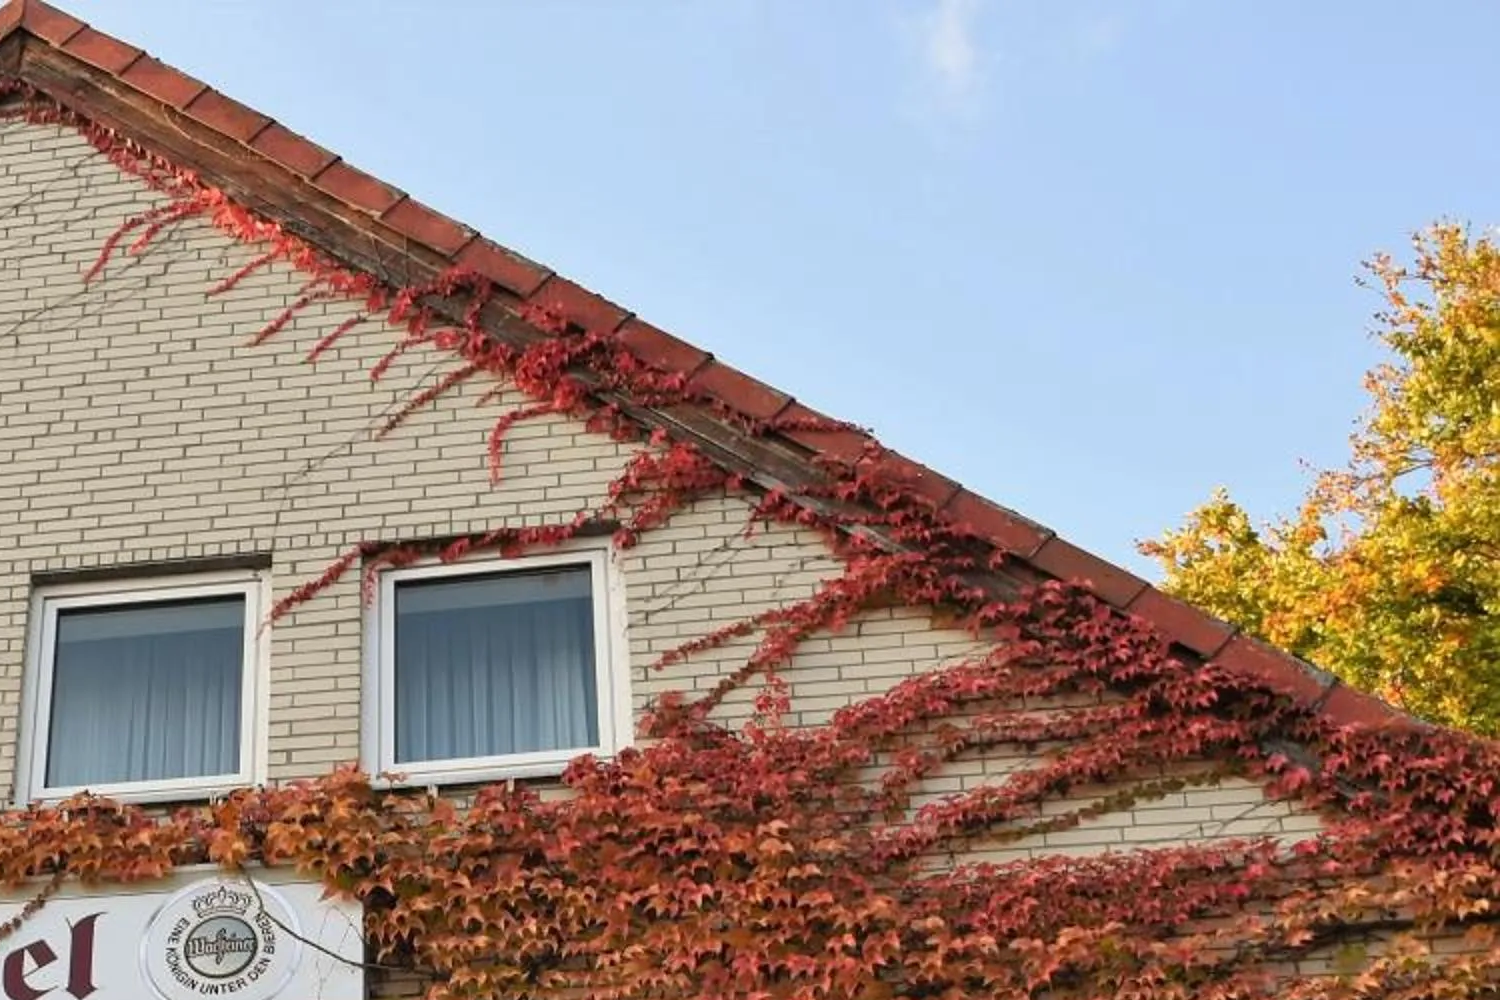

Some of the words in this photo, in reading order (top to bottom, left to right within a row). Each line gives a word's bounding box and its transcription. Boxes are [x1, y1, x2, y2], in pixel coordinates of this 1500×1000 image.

[167, 917, 191, 945] EINE
[199, 976, 249, 996] UNTER
[247, 957, 272, 981] DEN
